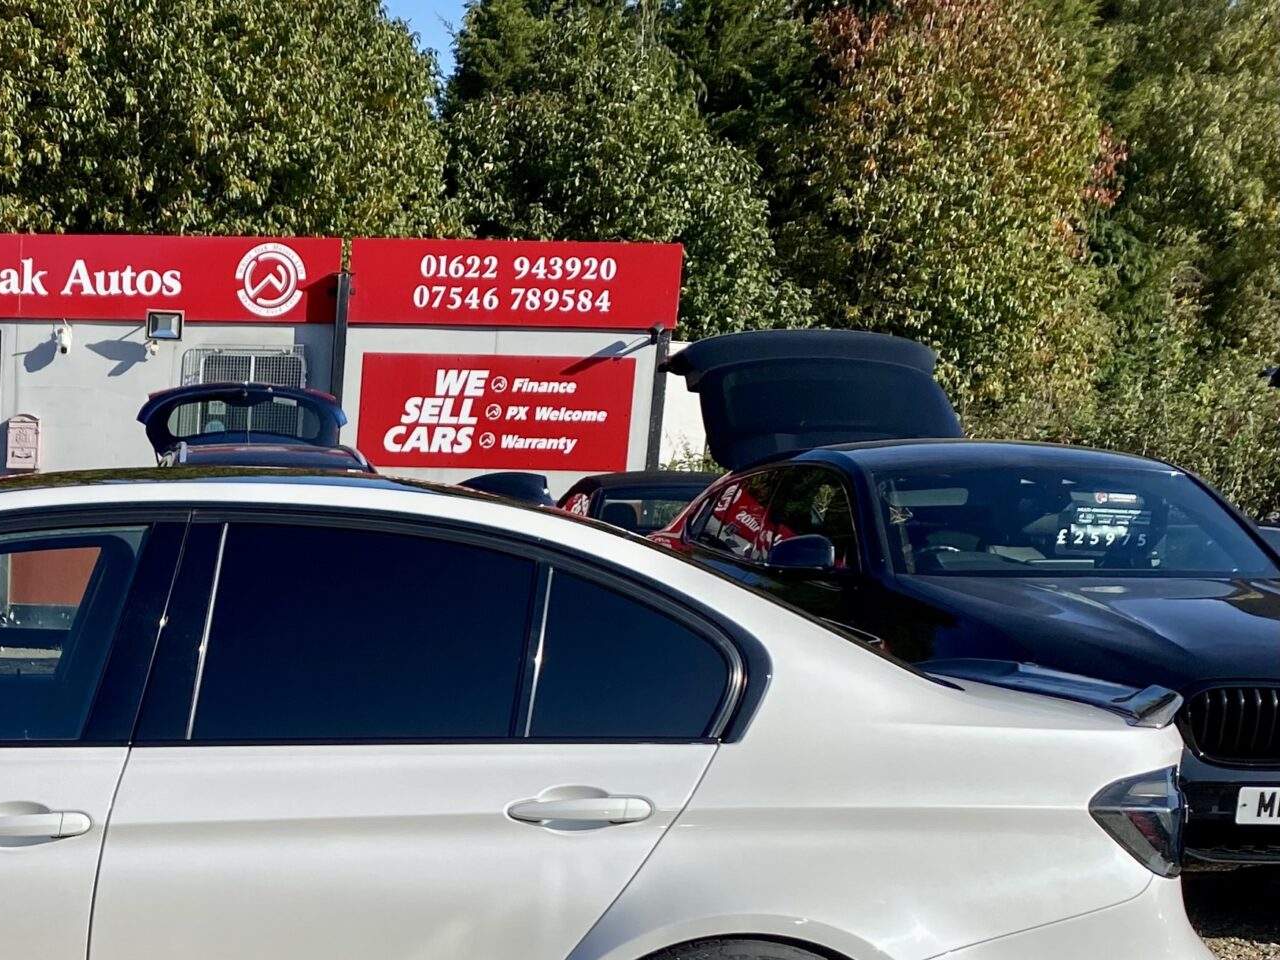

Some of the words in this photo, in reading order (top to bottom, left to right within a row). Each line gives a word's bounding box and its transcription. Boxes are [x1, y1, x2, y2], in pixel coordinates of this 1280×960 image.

[62, 258, 183, 297] Autos
[421, 254, 498, 278] 01622
[513, 257, 617, 281] 943920
[413, 285, 499, 309] 07546
[510, 287, 611, 312] 789584
[435, 369, 489, 397] WE
[512, 378, 577, 394] Finance
[401, 397, 479, 425] SELL
[505, 405, 528, 421] PX
[535, 406, 608, 423] Welcome
[383, 426, 474, 454] CARS
[501, 435, 577, 455] Warranty
[1256, 791, 1280, 818] M
